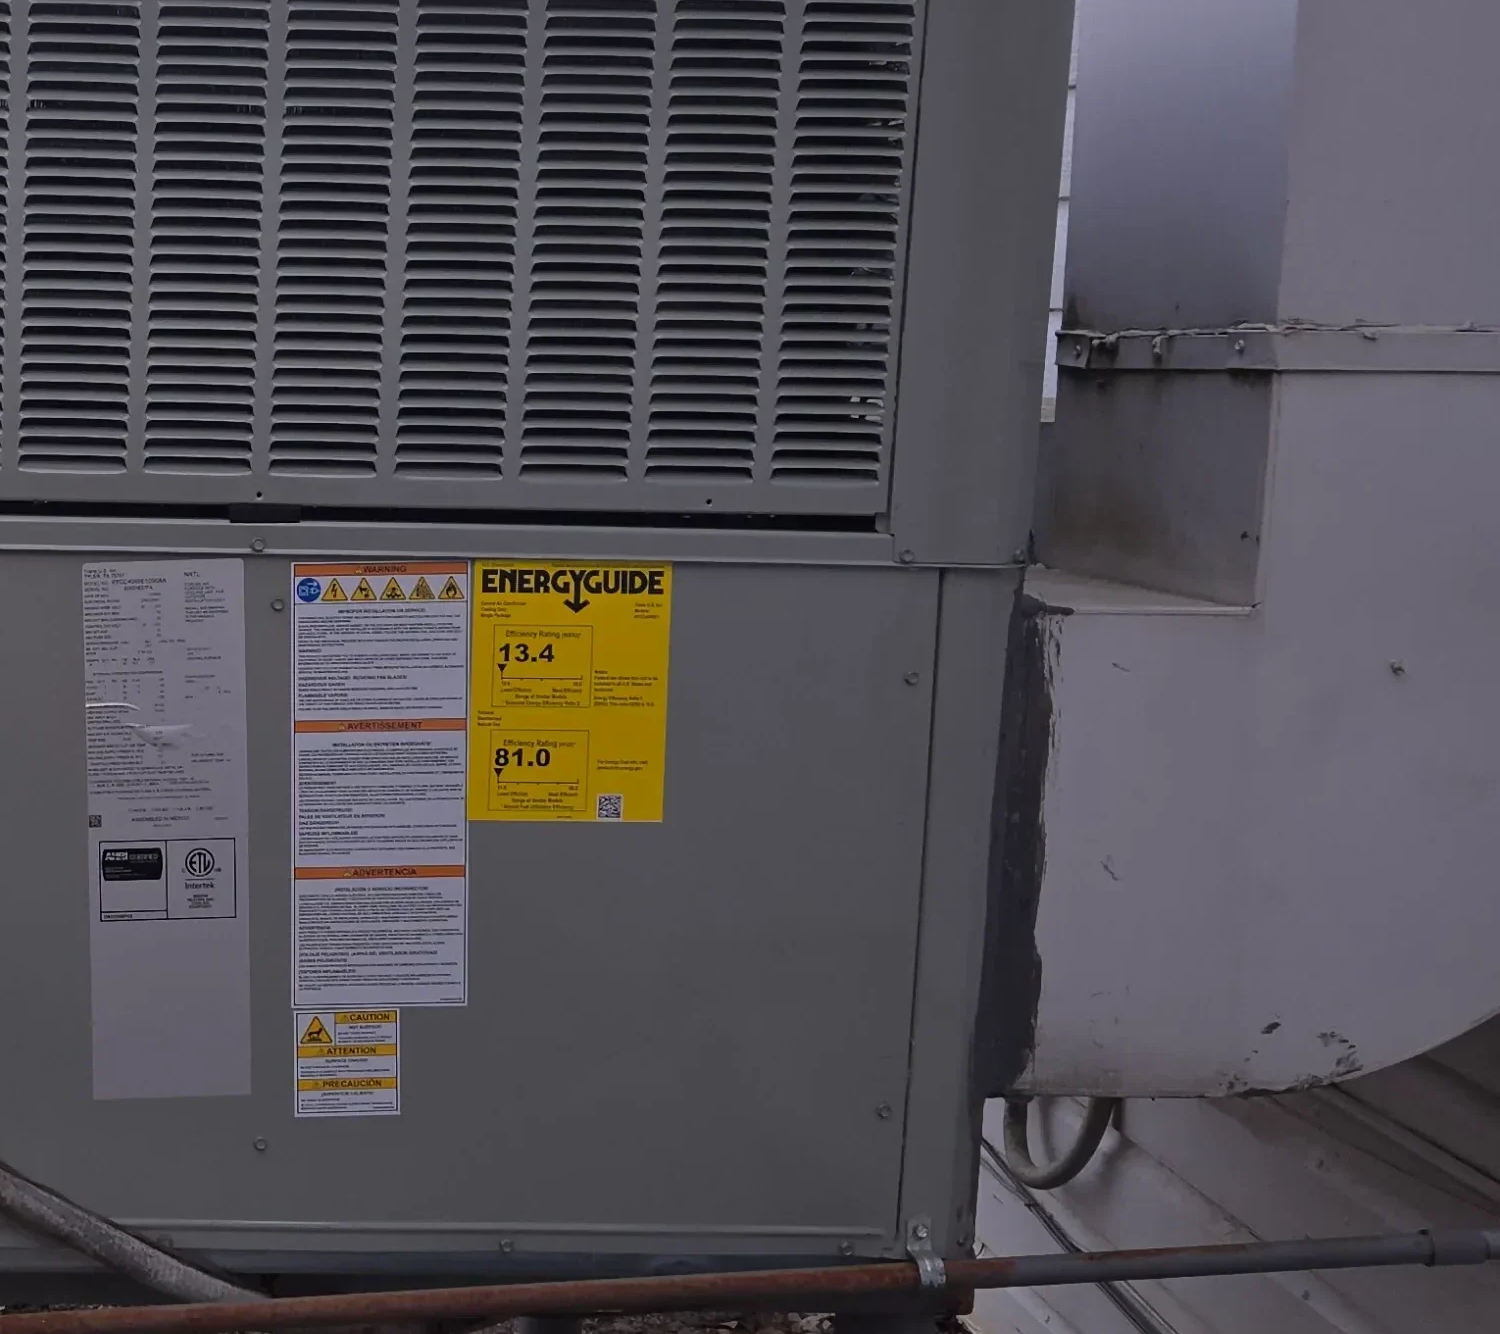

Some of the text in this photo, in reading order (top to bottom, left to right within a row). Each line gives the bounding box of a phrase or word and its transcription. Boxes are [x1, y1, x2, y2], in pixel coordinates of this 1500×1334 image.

[482, 569, 664, 603] ENERGYGUIDE
[506, 629, 537, 639] Efficiency
[539, 630, 560, 639] Rating
[499, 643, 555, 662] 13.4
[347, 721, 423, 730] AVERTISSEMENT
[503, 739, 557, 748] Efficiency Rating
[494, 748, 551, 767] 81.0
[189, 852, 211, 873] ETL
[352, 868, 417, 877] ADVERTENCIA
[184, 882, 215, 890] Intertek
[350, 1013, 390, 1022] CAUTION
[326, 1047, 377, 1056] ATTENTION
[322, 1078, 382, 1088] PRECAUCIÓN
